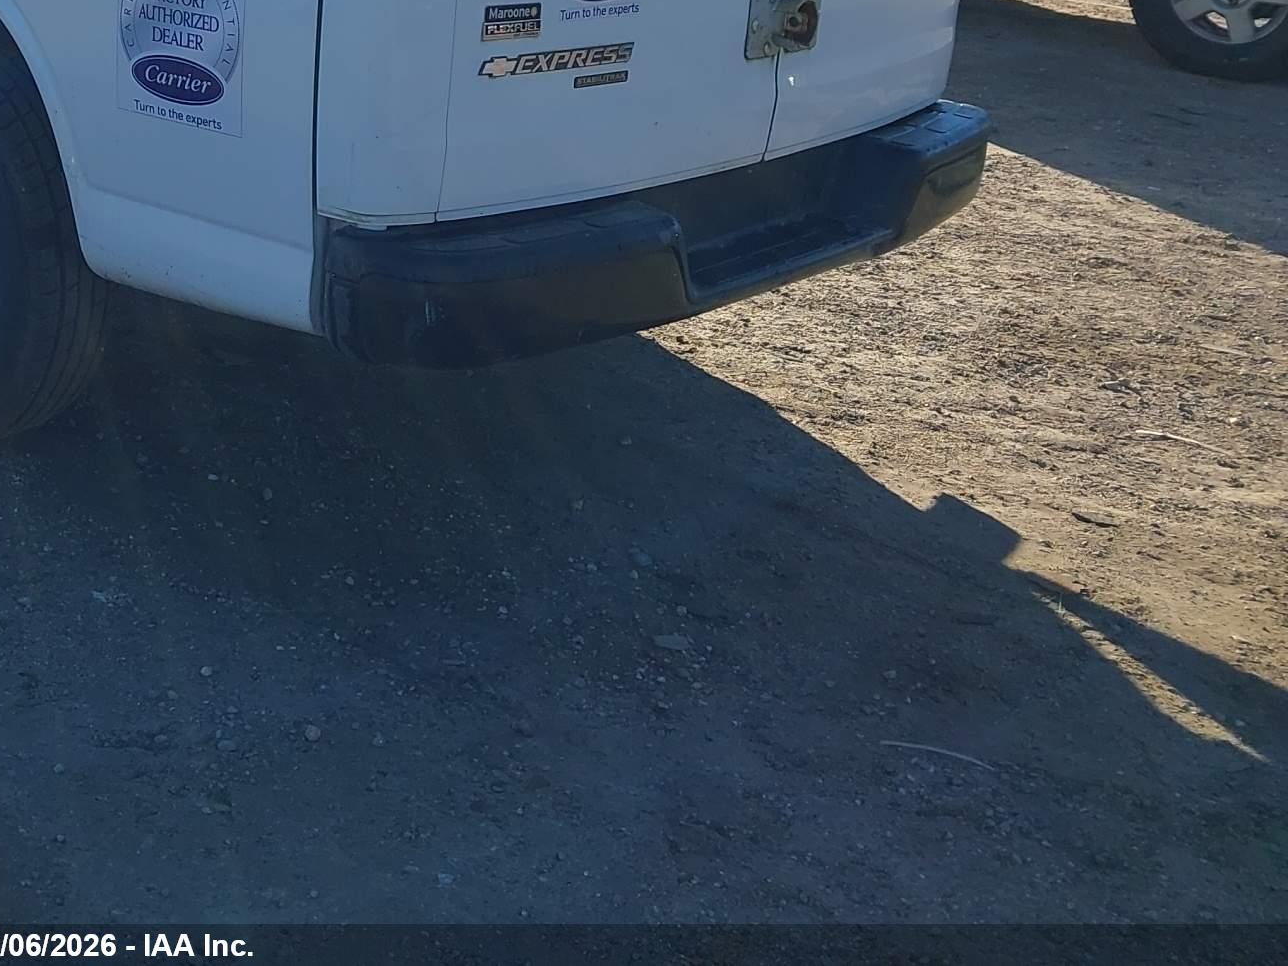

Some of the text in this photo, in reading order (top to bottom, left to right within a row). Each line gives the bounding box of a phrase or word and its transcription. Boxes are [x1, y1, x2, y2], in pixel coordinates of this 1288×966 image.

[138, 2, 220, 33] AUTHORIZED
[488, 8, 531, 20] Maroone
[560, 2, 640, 22] Turn to the experts
[151, 26, 204, 52] DEALER
[487, 21, 540, 35] FLEXFUEL
[515, 43, 633, 74] EXPRESS
[144, 64, 212, 94] Carrier
[133, 98, 223, 130] Turn to the experts
